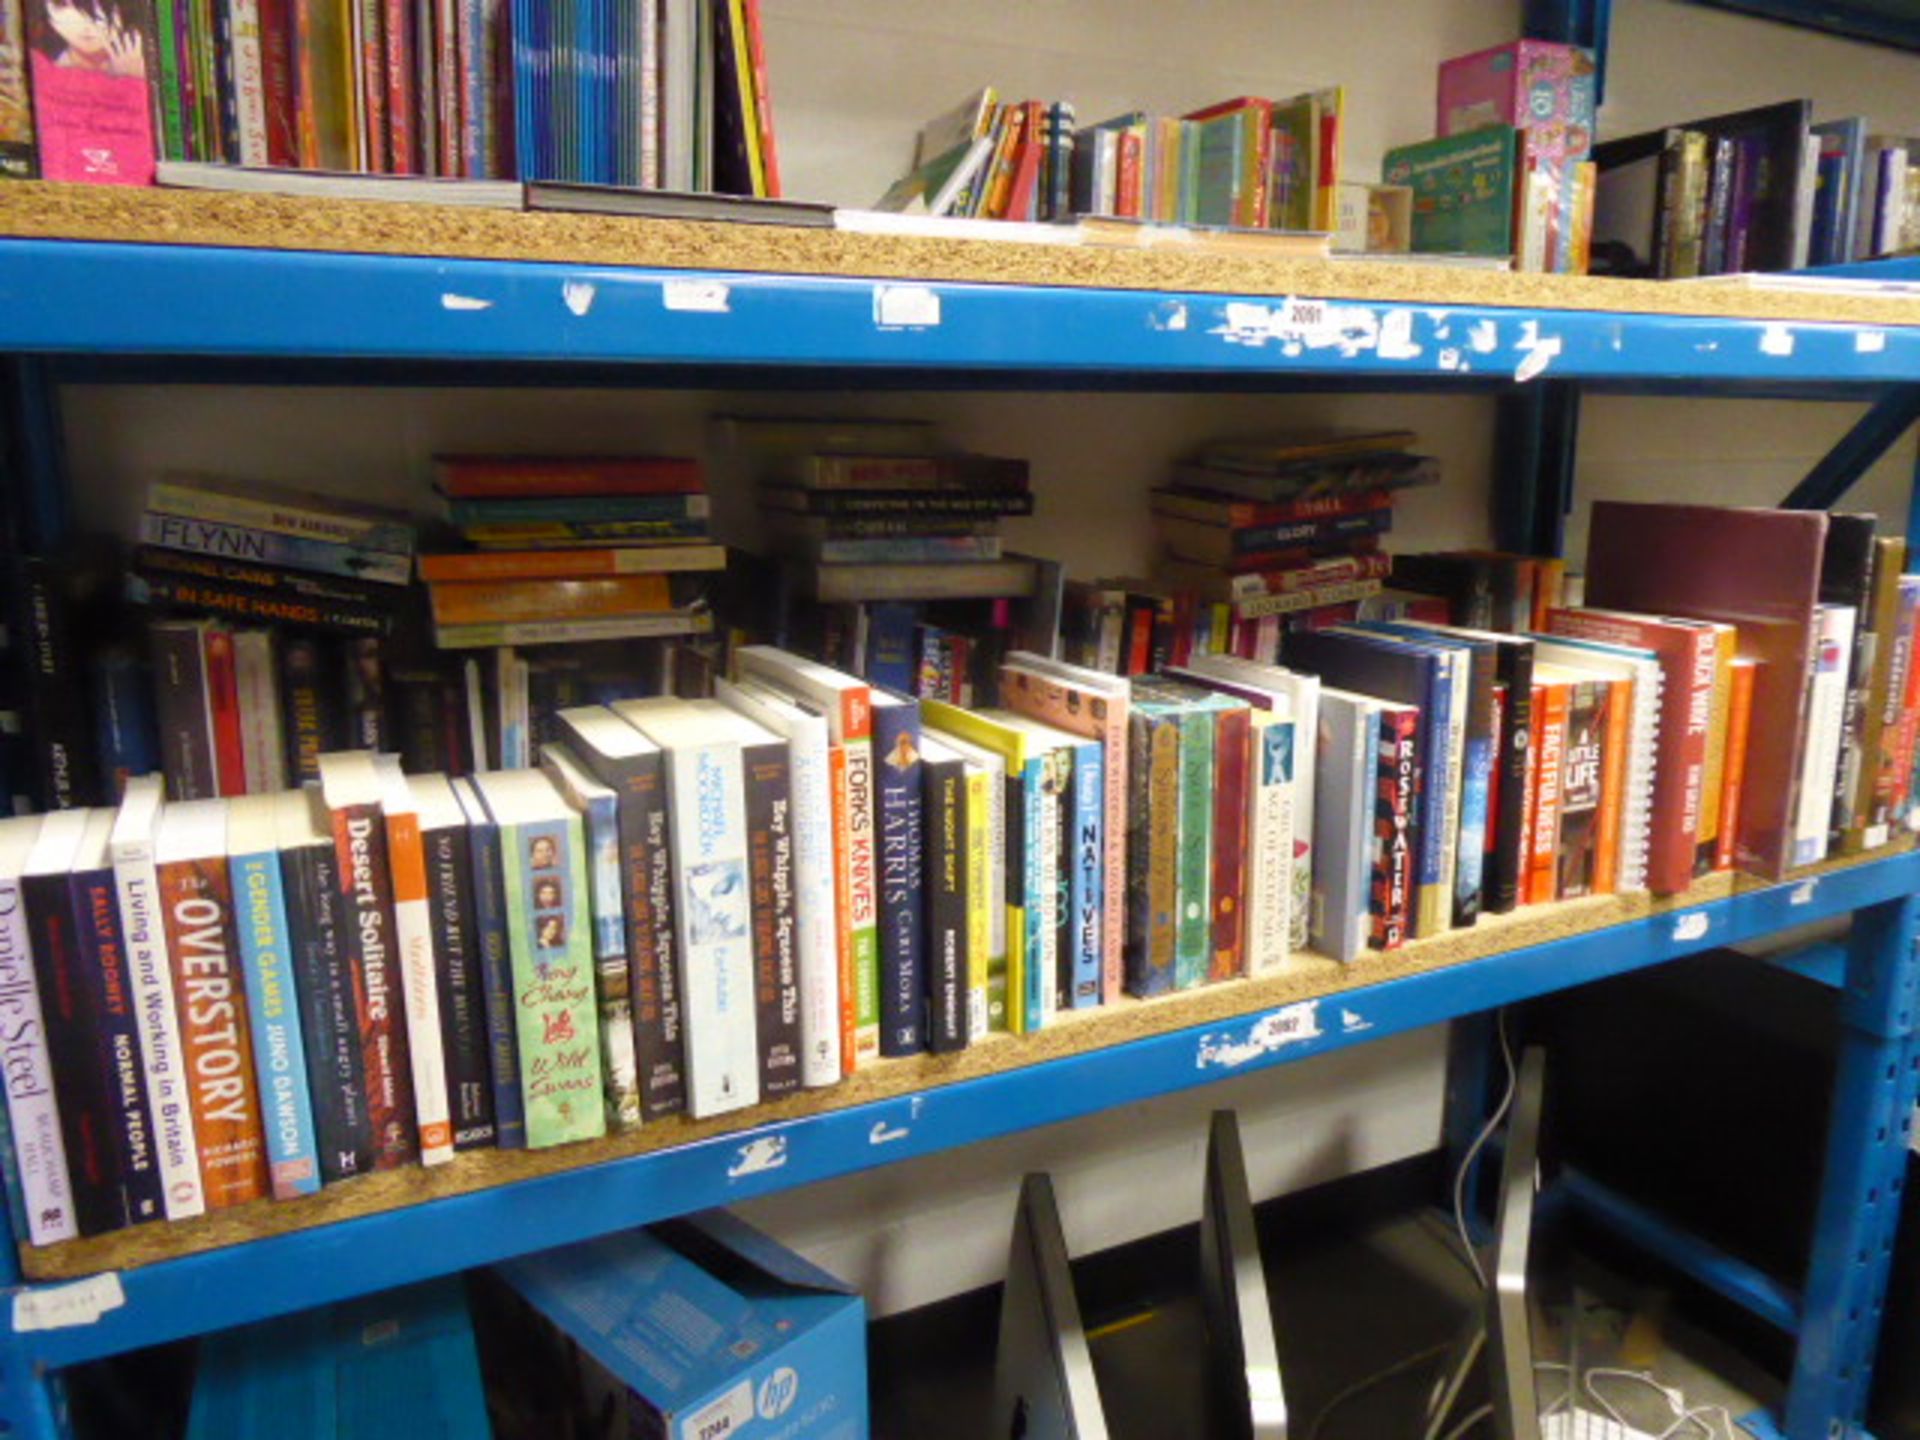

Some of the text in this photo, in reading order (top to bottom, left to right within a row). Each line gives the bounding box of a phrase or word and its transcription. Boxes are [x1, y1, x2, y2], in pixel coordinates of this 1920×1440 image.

[160, 516, 267, 559] FLYNN
[1694, 633, 1716, 685] BLACK
[1565, 764, 1600, 791] LIFE
[1580, 729, 1590, 746] A
[648, 811, 663, 846] Hey
[1267, 789, 1279, 820] AGE
[1391, 740, 1415, 906] ROSEWATER
[1534, 724, 1561, 855] FACTFULNESS
[848, 755, 872, 924] FORKS KNIVES
[883, 785, 907, 905] HARRIS
[909, 797, 921, 890] THOMAS
[943, 777, 958, 893] THE NIGHT SHIFT
[1265, 829, 1277, 850] OF
[248, 873, 277, 949] GENDER
[347, 818, 390, 1021] Desert Solitaire
[650, 847, 671, 930] Whipple,
[770, 799, 798, 1025] Hey Whipple, Squeeze This
[1081, 823, 1098, 965] NATIVES
[89, 886, 127, 1015] SALLY ROONEY
[325, 929, 338, 956] way
[655, 930, 675, 1002] Squeeze
[946, 928, 957, 976] ROBERT
[126, 879, 186, 1168] Living and Working in Britain
[173, 898, 248, 1123] OVERSTORY
[259, 953, 283, 1019] GAMES
[663, 1002, 679, 1043] This
[3, 1017, 50, 1100] Steel
[265, 1024, 301, 1157] JUNO DAWSON
[112, 1034, 148, 1173] NORMAL PEOPLE
[764, 1374, 795, 1414] hp
